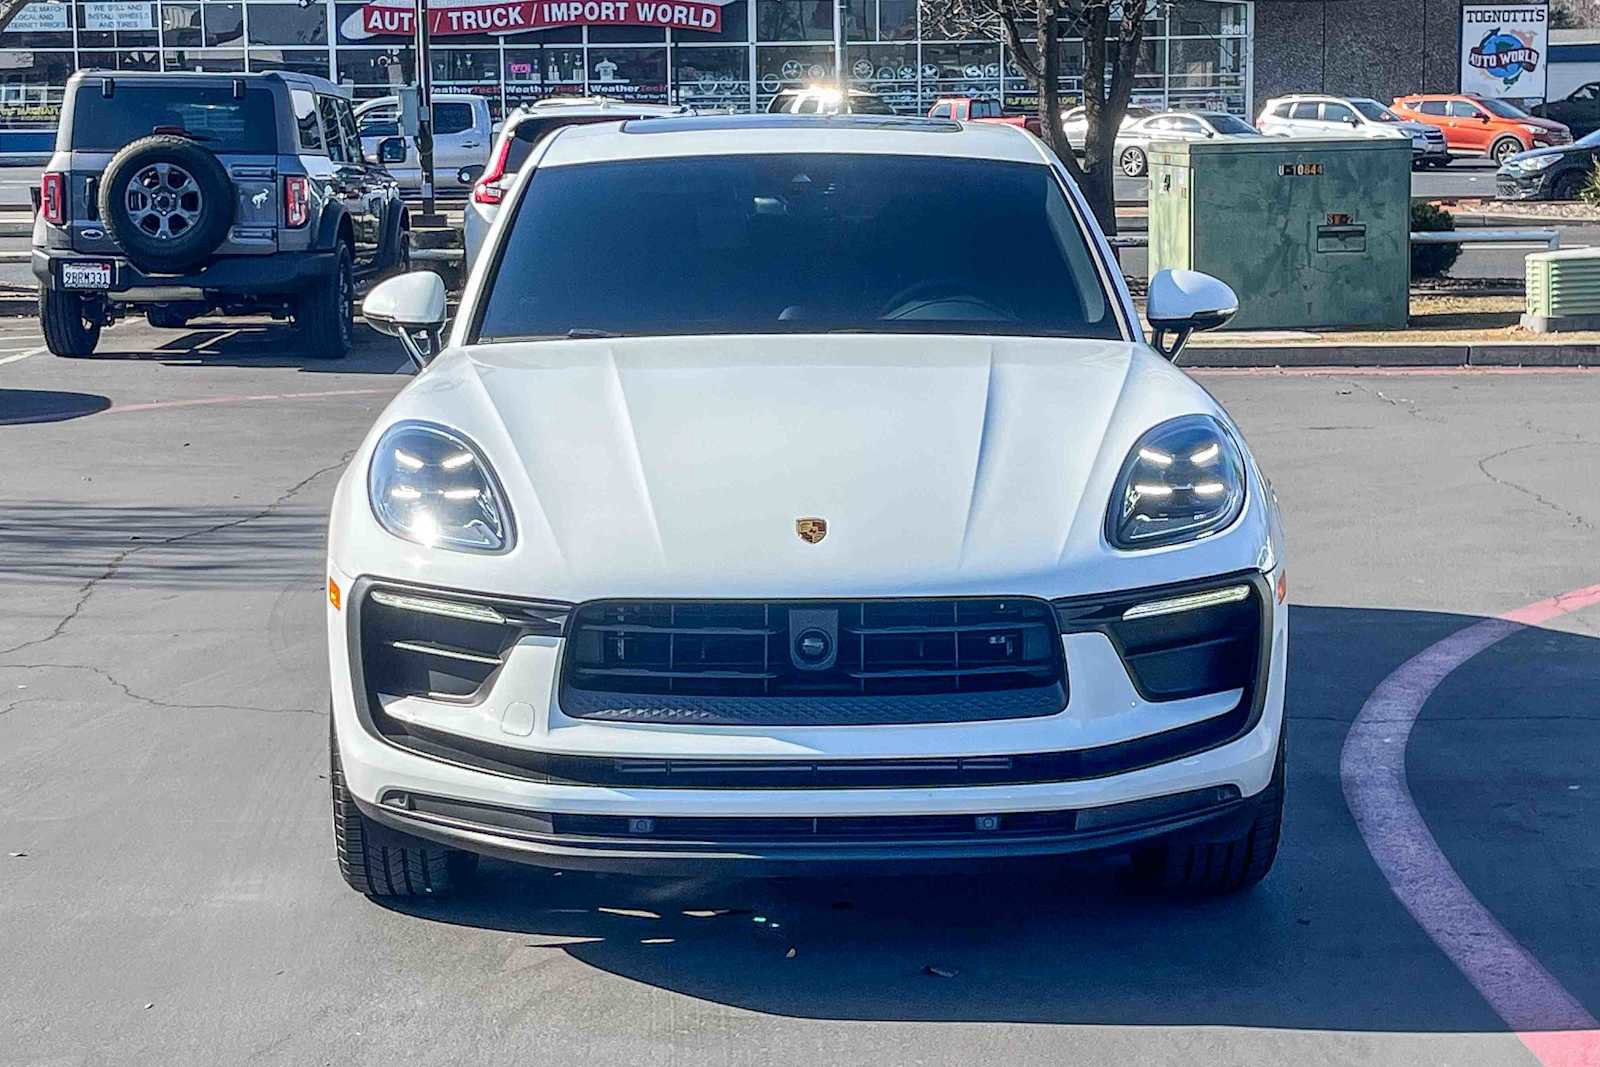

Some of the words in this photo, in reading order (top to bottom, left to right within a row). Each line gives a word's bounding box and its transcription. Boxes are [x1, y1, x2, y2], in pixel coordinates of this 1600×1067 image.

[368, 10, 418, 32] AUT
[447, 6, 524, 31] TRUCK
[543, 2, 629, 22] IMPORT
[636, 3, 717, 28] WORLD
[1466, 8, 1546, 23] TOGNOTTI'S
[1470, 52, 1497, 67] AUTO
[1499, 49, 1537, 66] WORLD
